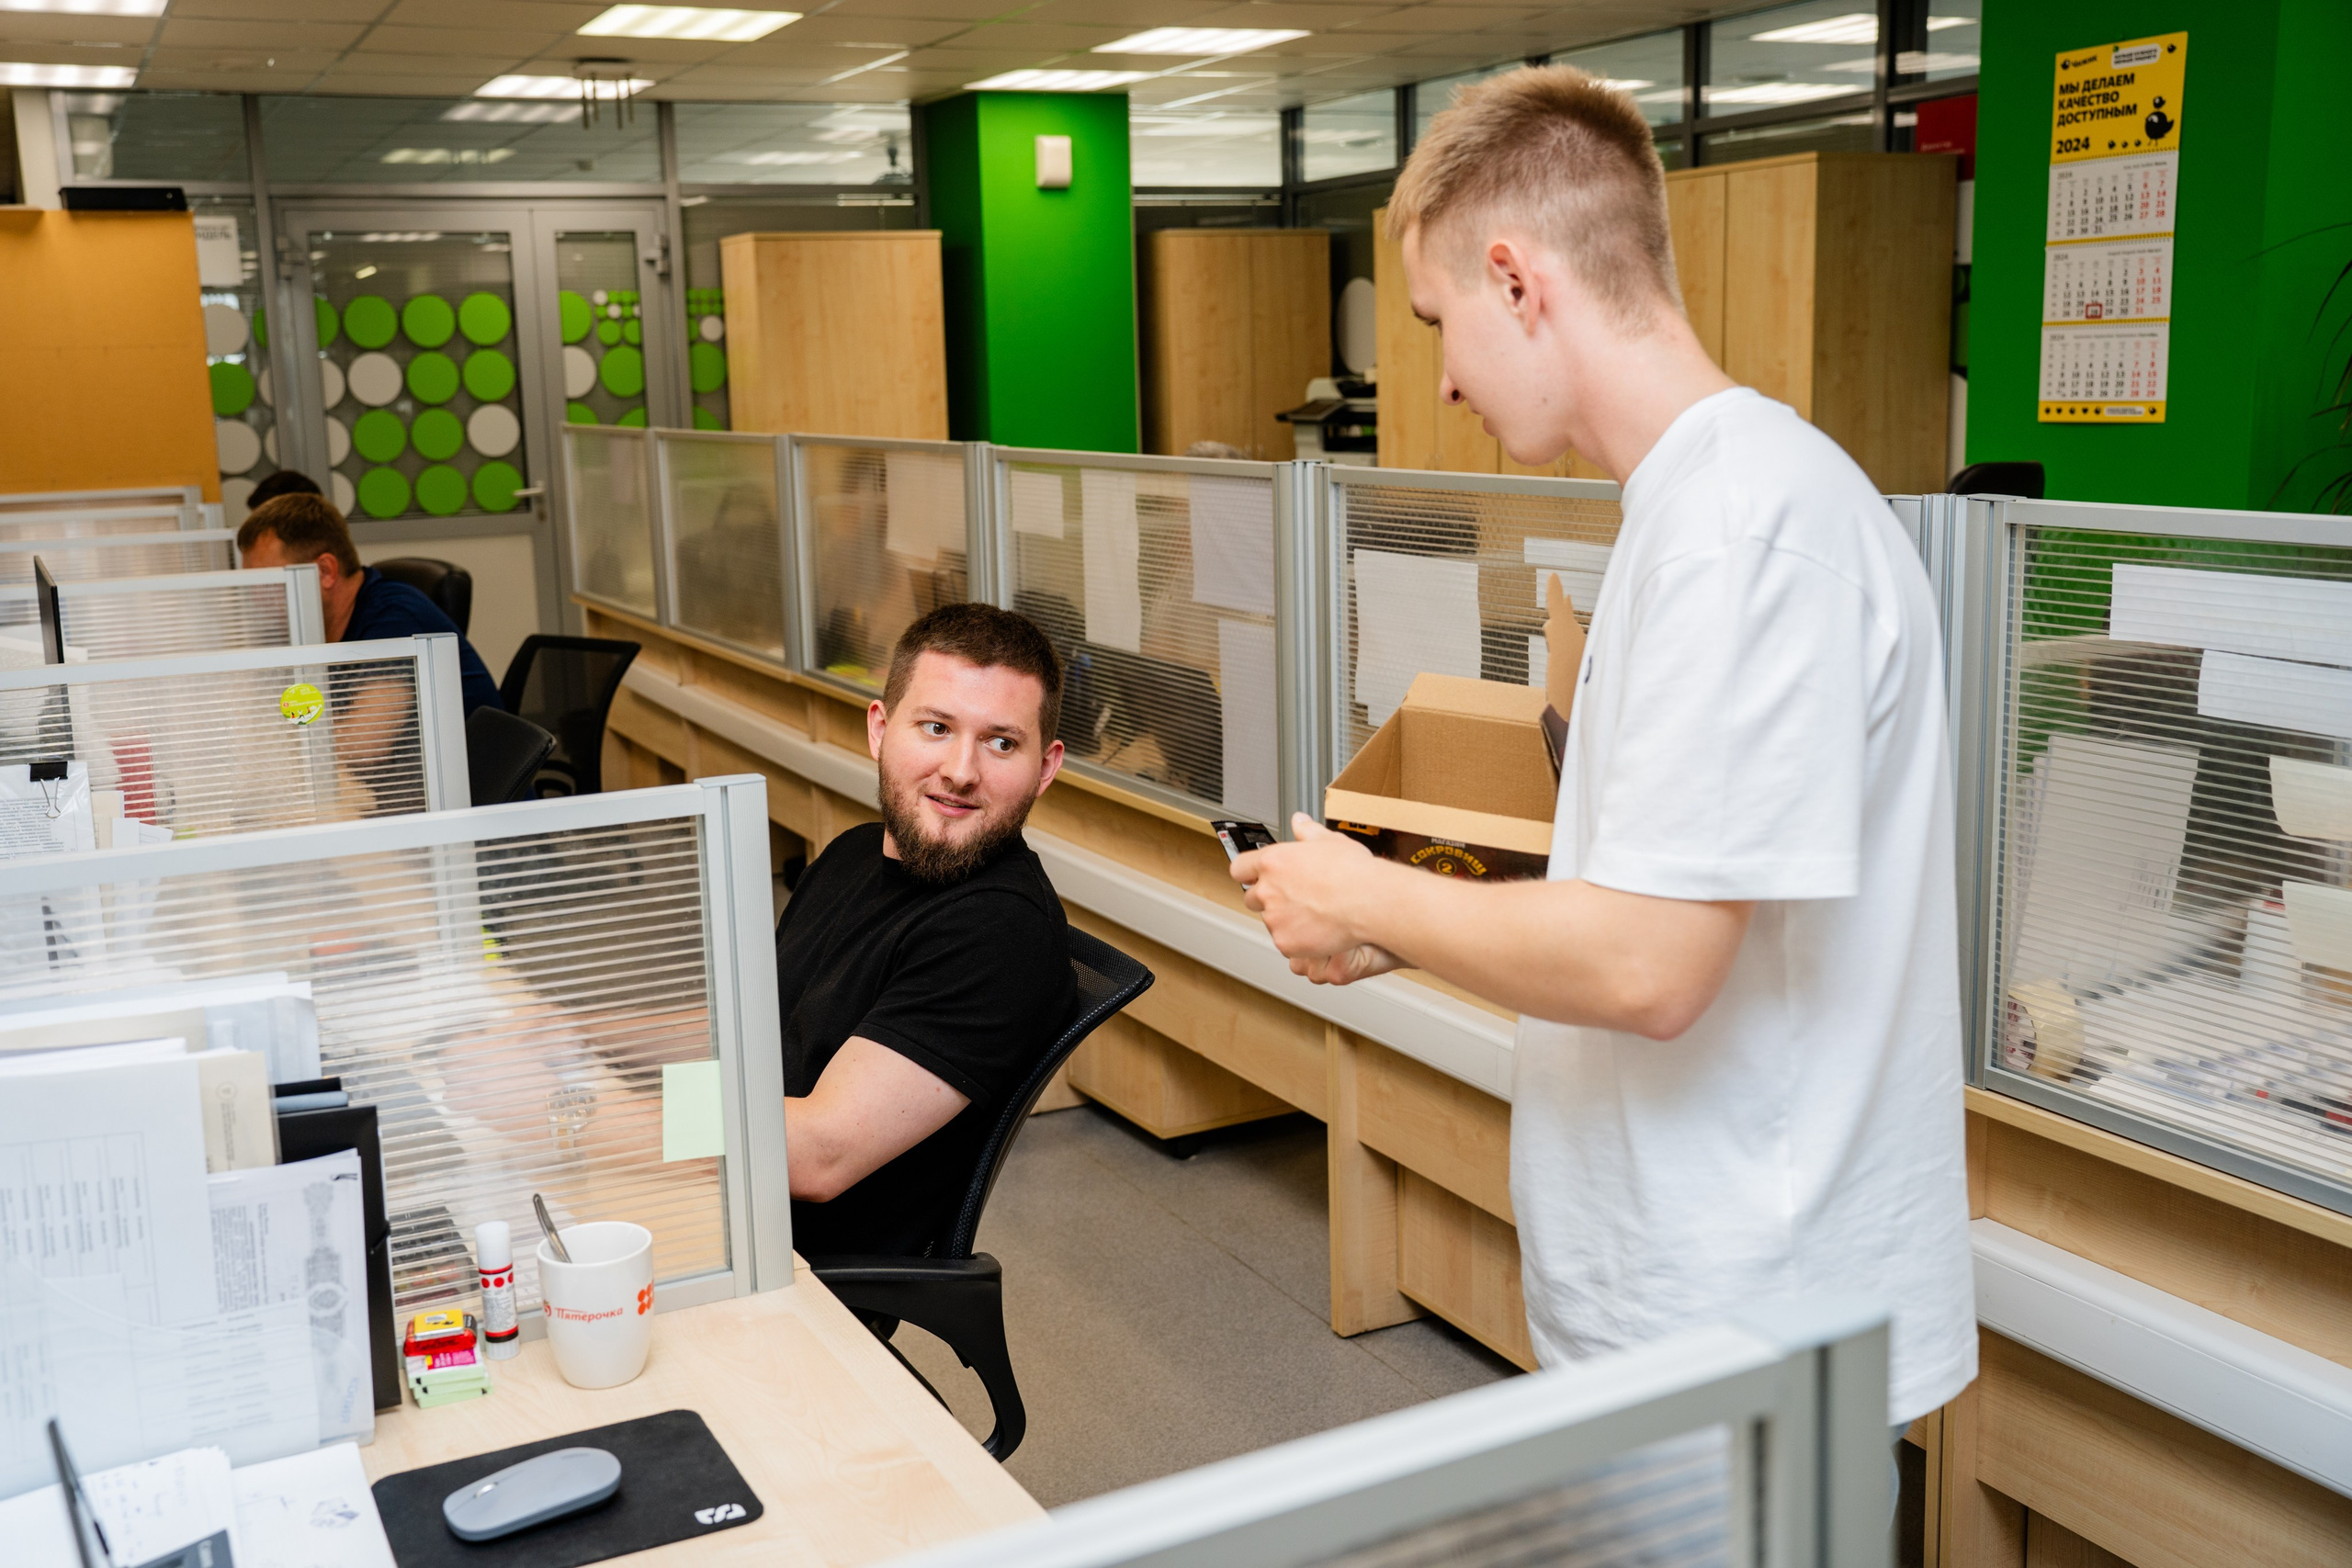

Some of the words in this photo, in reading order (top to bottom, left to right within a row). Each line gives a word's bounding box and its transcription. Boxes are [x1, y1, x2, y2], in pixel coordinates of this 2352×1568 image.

[2059, 83, 2079, 96] МЫ
[2082, 73, 2135, 93] ДЕЛАЕМ
[2058, 91, 2120, 110] КАЧЕСТВО
[2057, 103, 2137, 128] ДОСТУПНЫМ
[2056, 136, 2091, 154] 2024
[1410, 845, 1487, 876] СОКРОВИЩ
[1442, 862, 1453, 874] 2
